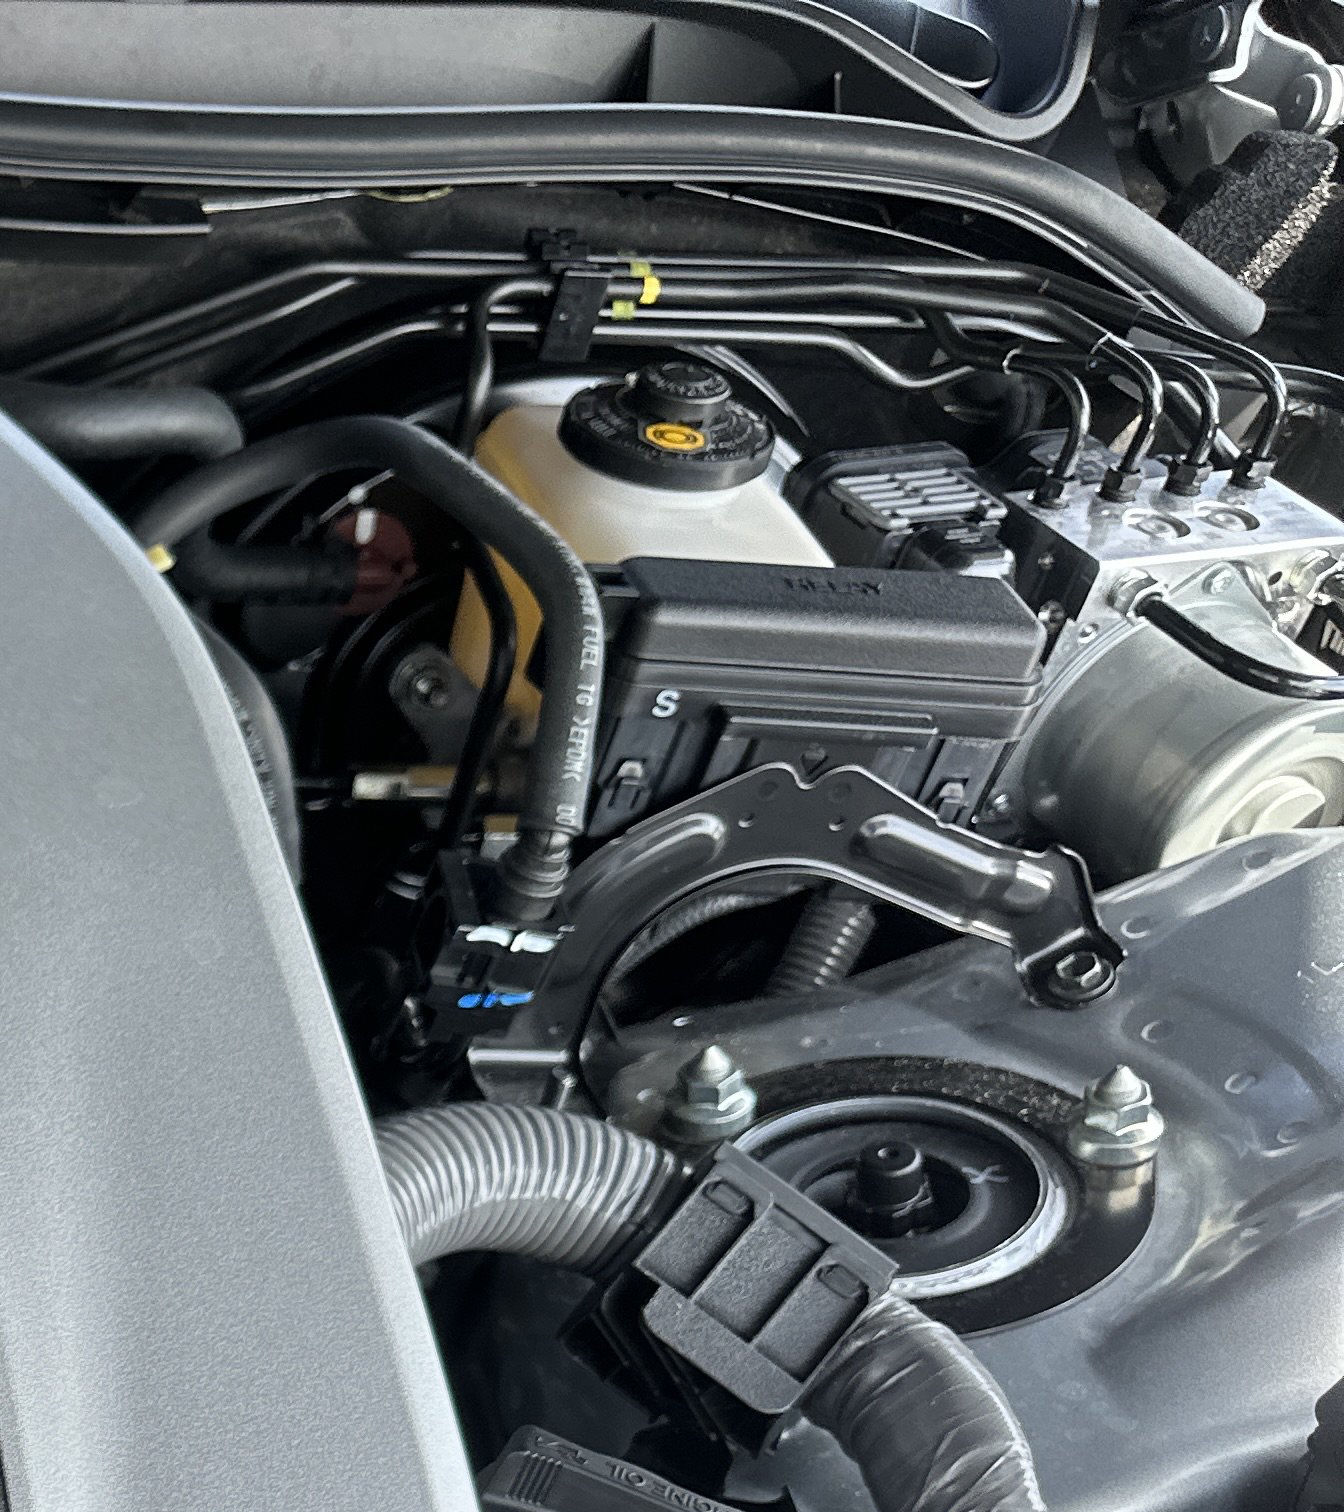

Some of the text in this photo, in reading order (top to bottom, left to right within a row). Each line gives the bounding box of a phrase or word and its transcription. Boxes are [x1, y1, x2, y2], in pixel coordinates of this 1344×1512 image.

[578, 625, 600, 671] FUEL
[575, 683, 596, 708] TG
[652, 689, 680, 718] S
[605, 1460, 647, 1488] OIL
